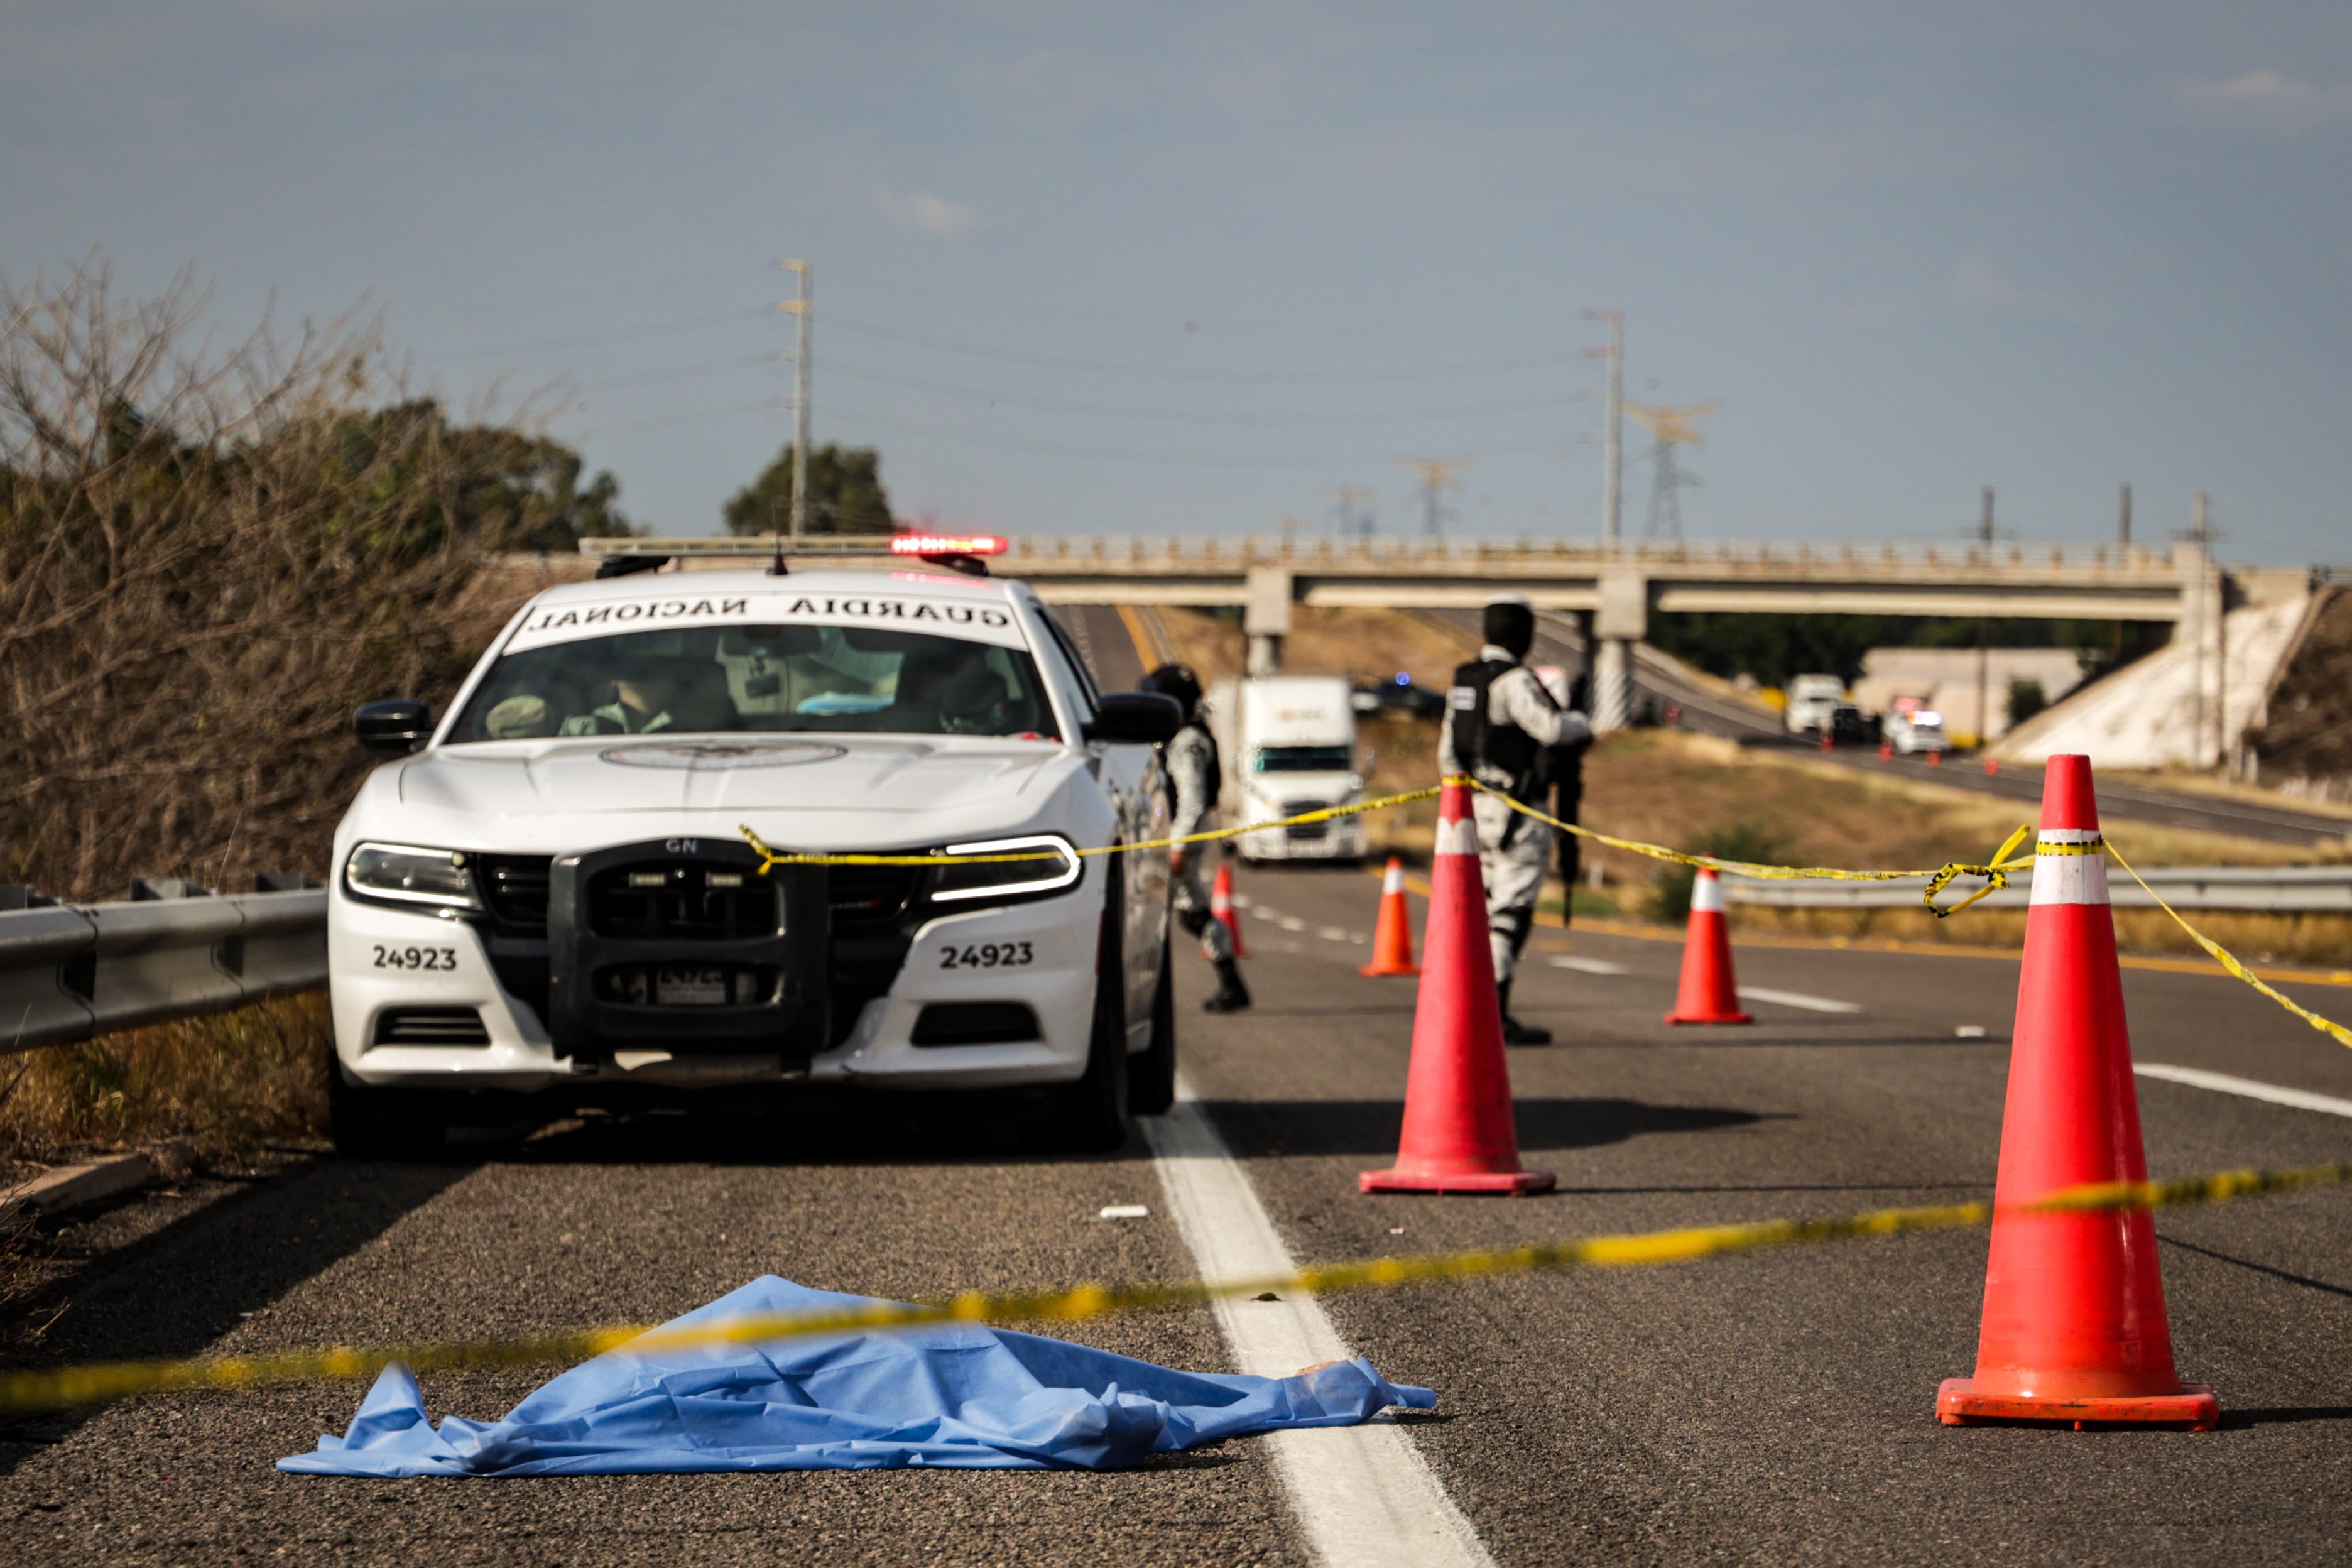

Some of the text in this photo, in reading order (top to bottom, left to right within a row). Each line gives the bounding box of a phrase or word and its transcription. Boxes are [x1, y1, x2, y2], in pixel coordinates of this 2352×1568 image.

[665, 838, 697, 854] GN
[373, 945, 457, 972] 24923
[940, 941, 1033, 969] 24923
